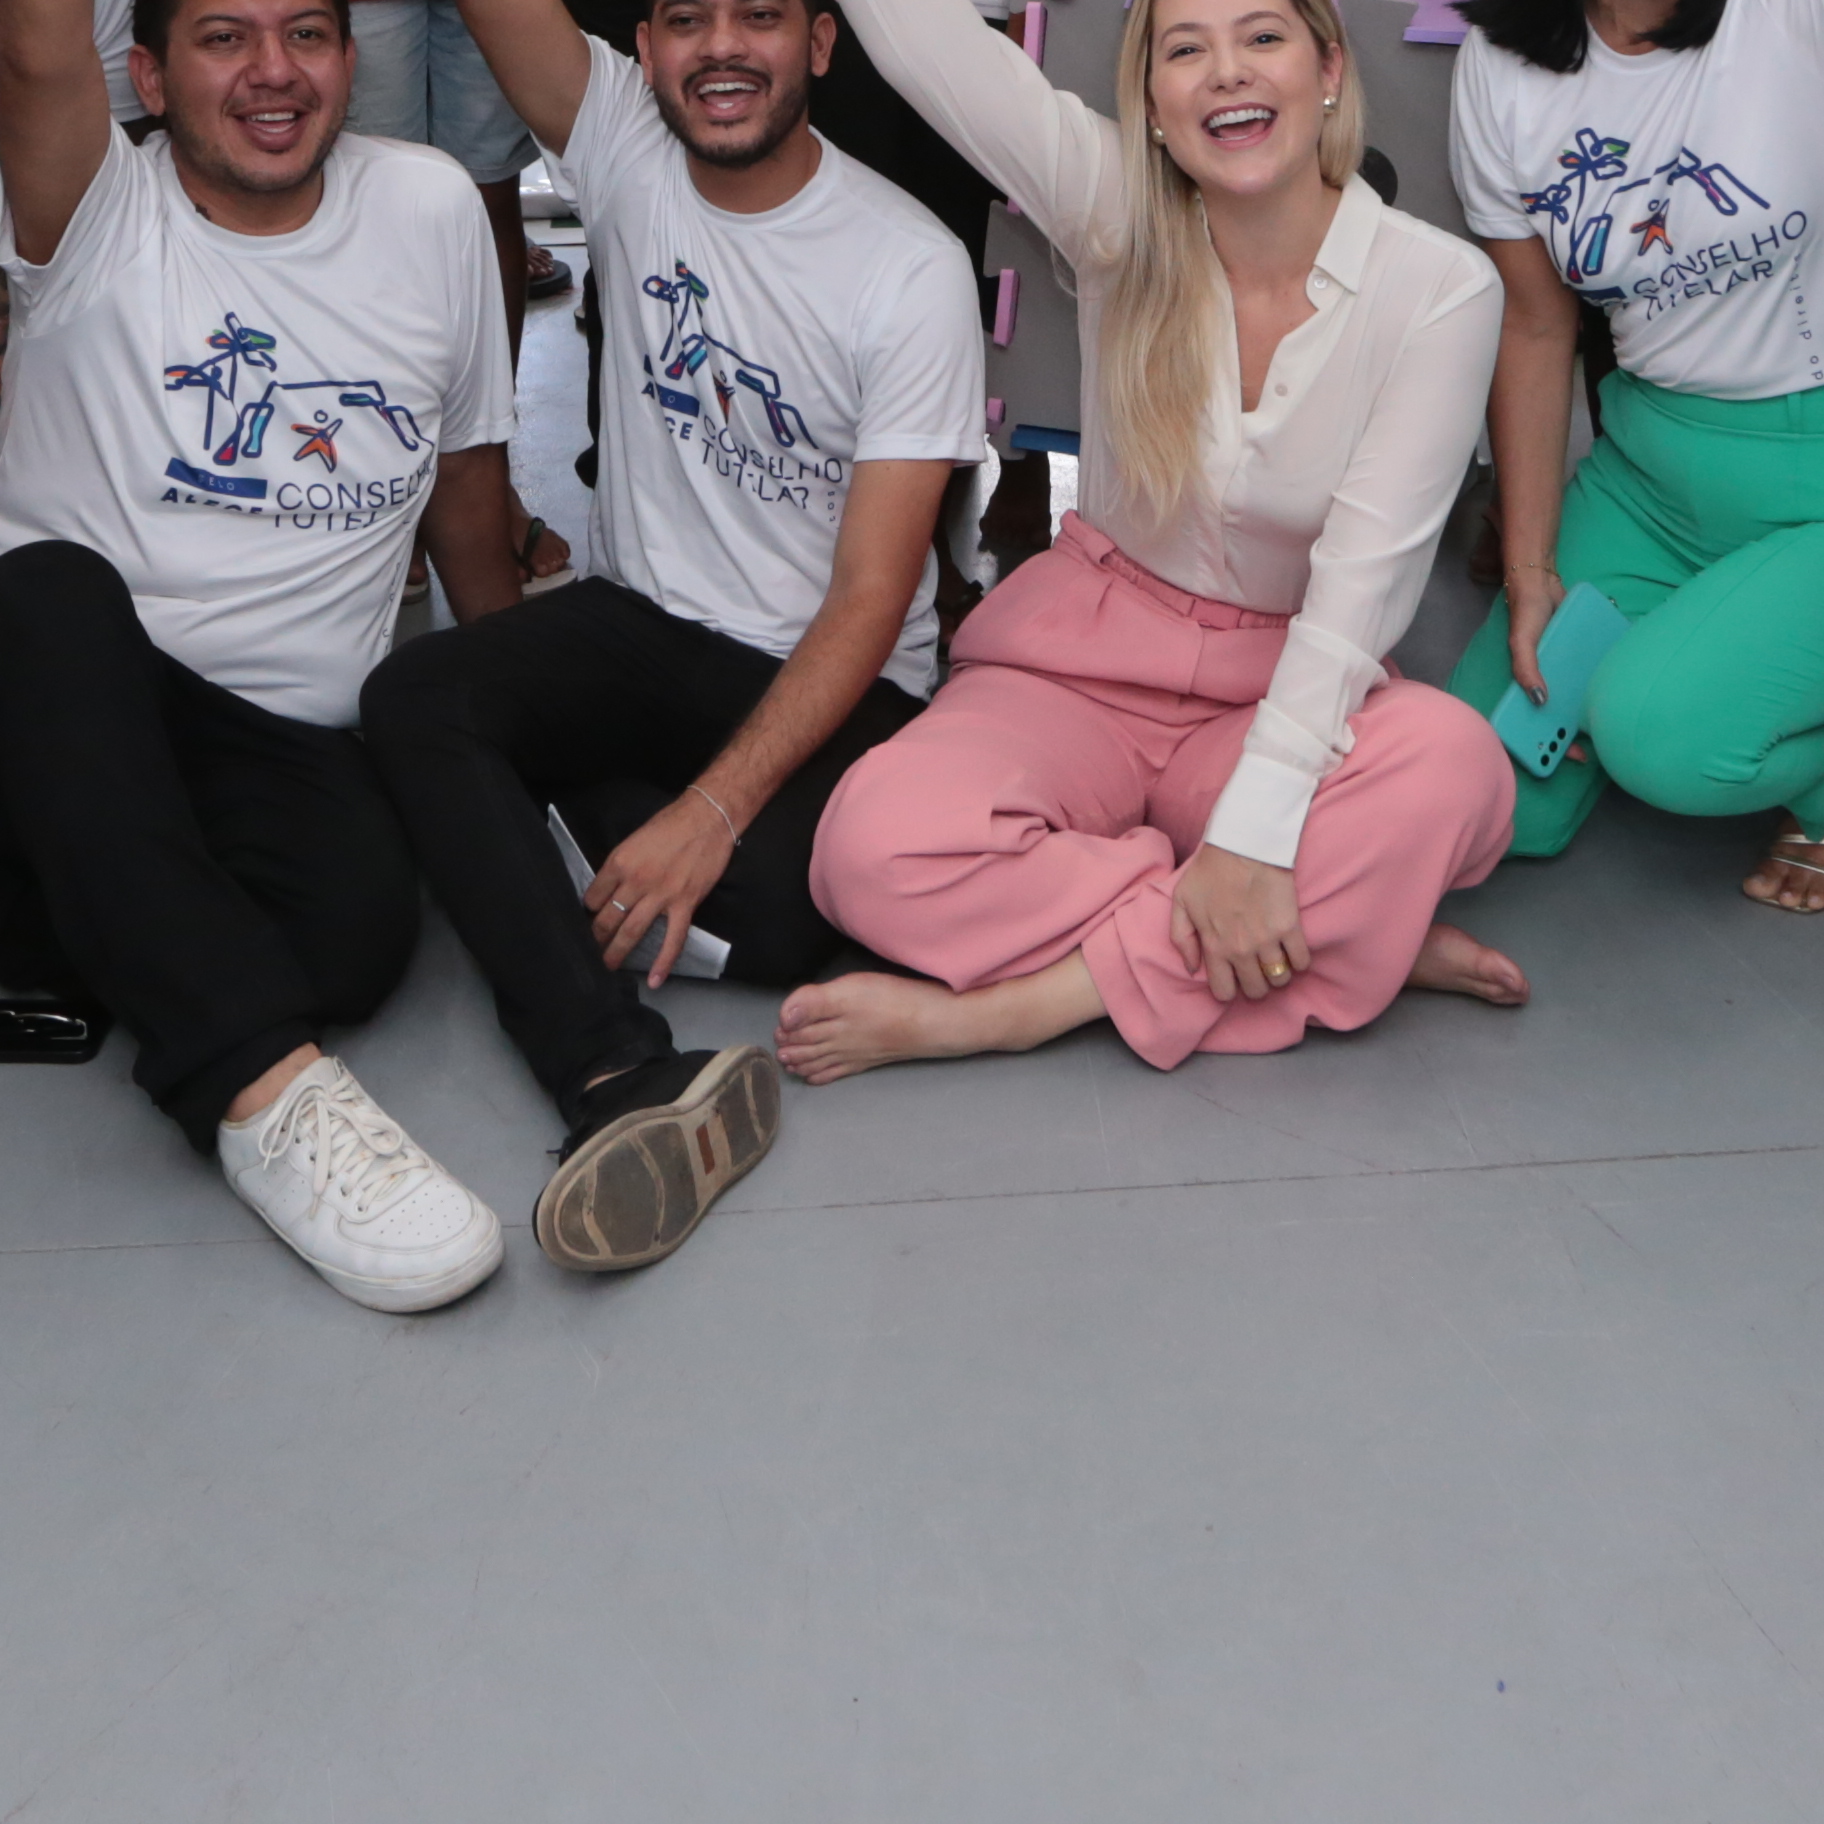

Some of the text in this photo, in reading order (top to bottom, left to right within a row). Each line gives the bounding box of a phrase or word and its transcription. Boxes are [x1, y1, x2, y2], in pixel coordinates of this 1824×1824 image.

[1632, 210, 1808, 296] CONSELHO
[1643, 260, 1774, 322] TELAR
[704, 414, 843, 483] CONSELHO
